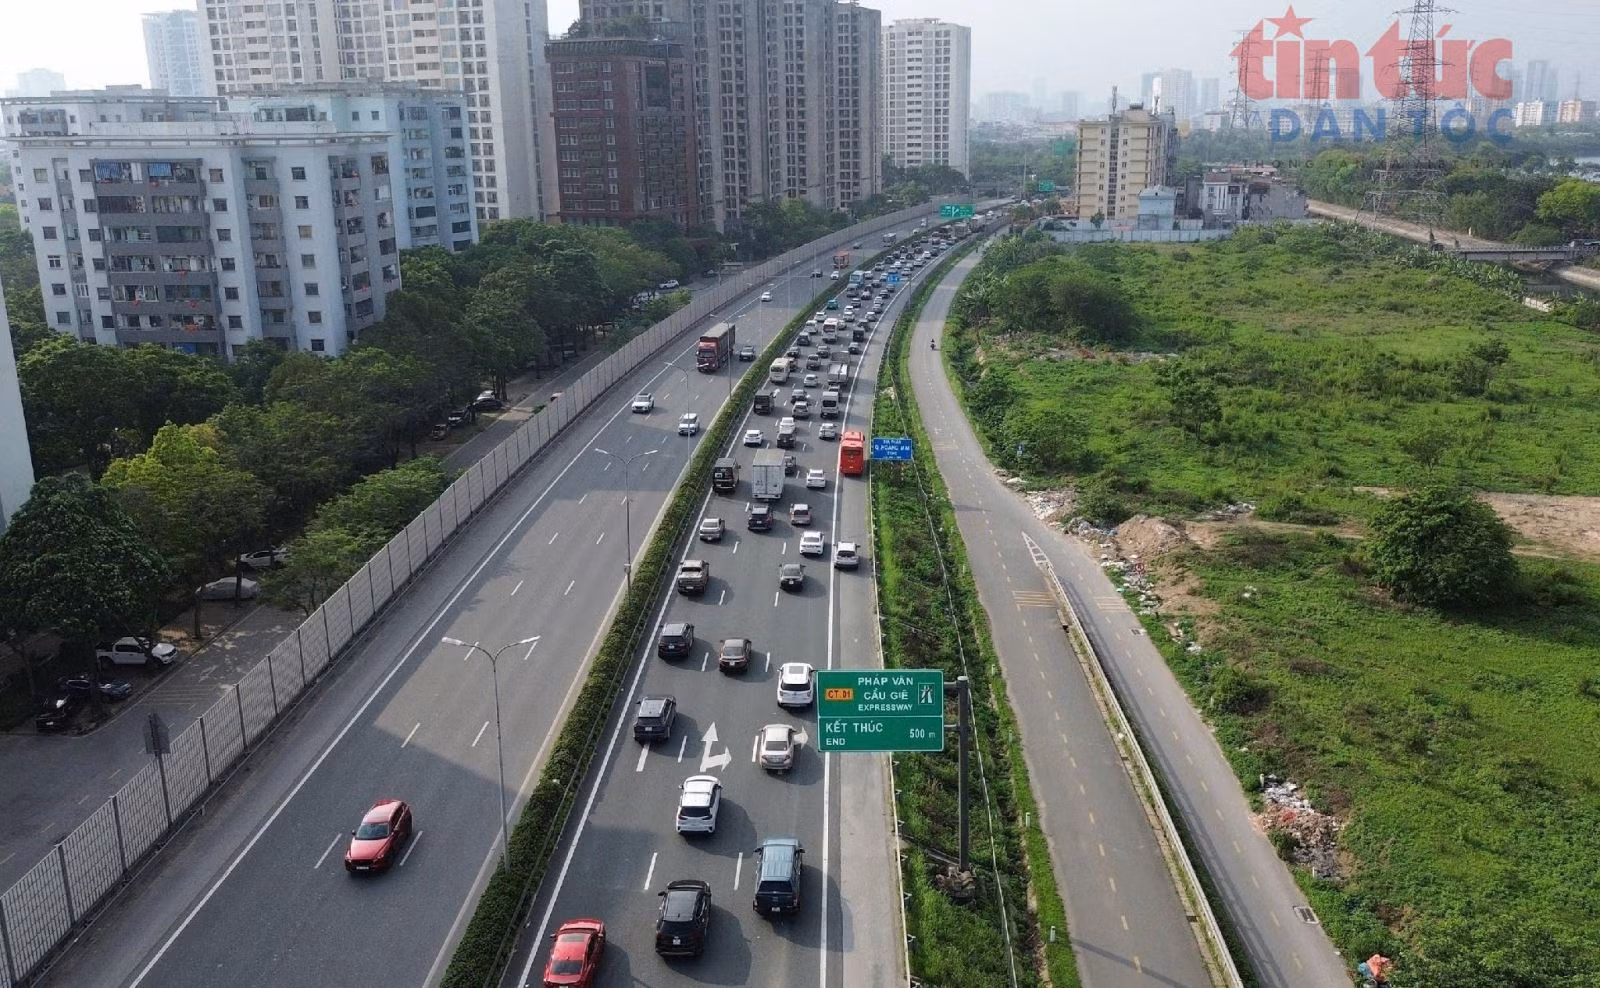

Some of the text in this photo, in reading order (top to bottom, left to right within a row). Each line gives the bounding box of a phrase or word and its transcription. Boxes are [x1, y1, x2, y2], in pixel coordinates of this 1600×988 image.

[858, 674, 888, 686] PHÁP
[825, 719, 848, 733] KẾT
[909, 728, 925, 738] 500
[825, 738, 846, 746] END
